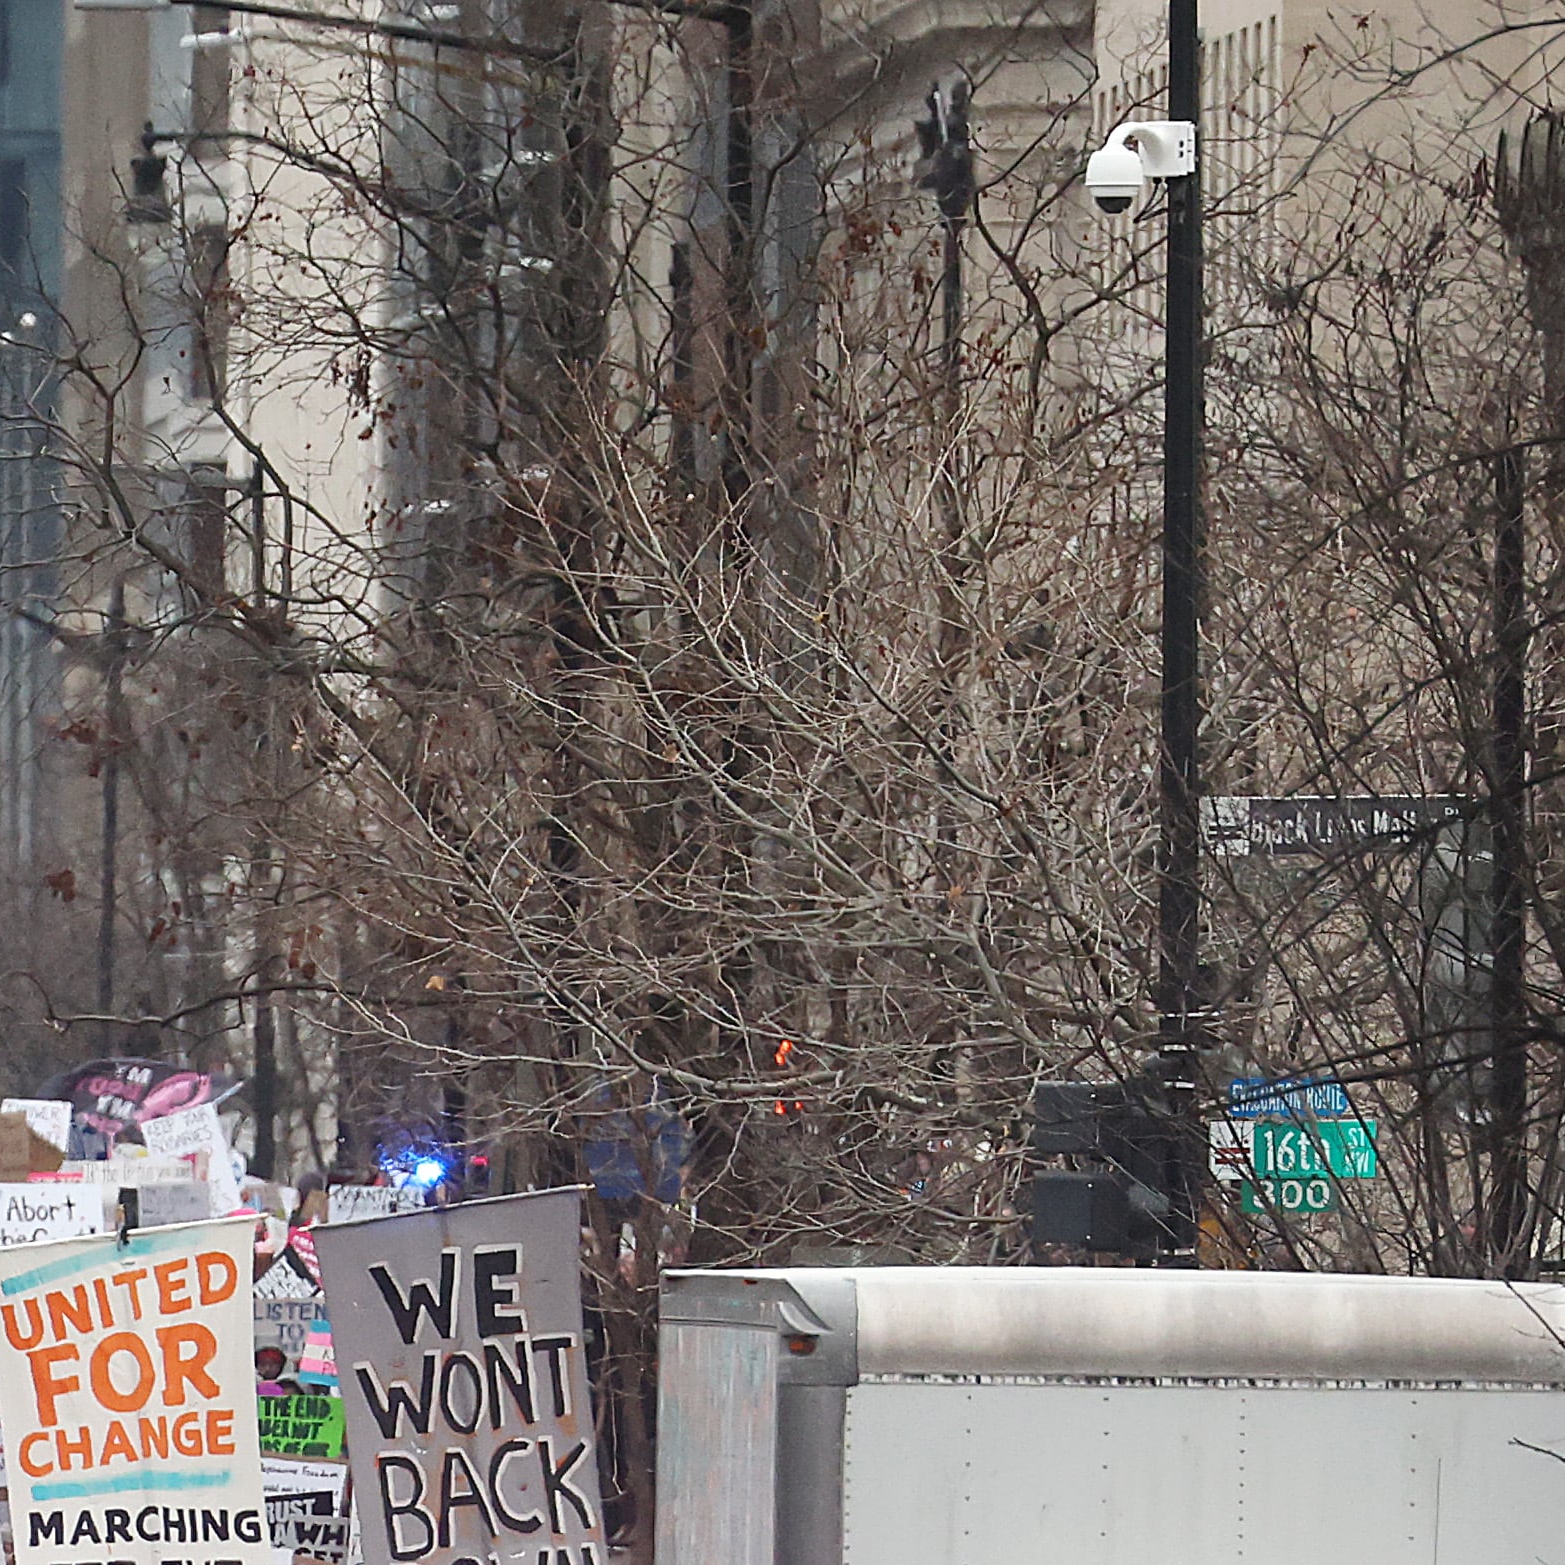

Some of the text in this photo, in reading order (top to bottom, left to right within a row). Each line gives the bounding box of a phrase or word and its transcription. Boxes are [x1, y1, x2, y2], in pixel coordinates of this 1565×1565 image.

[1307, 1084, 1344, 1110] ROUTE
[1264, 1131, 1330, 1172] 16th
[1348, 1128, 1366, 1147] ST
[6, 1196, 77, 1222] Abort
[0, 1250, 239, 1352] UNITED
[367, 1243, 525, 1346] WE
[276, 1323, 304, 1341] TO
[27, 1321, 222, 1428] FOR
[352, 1334, 576, 1441] WONT
[261, 1397, 292, 1417] THE
[18, 1409, 237, 1478] CHANGE
[376, 1435, 596, 1564] BACK
[28, 1506, 262, 1548] MARCHING
